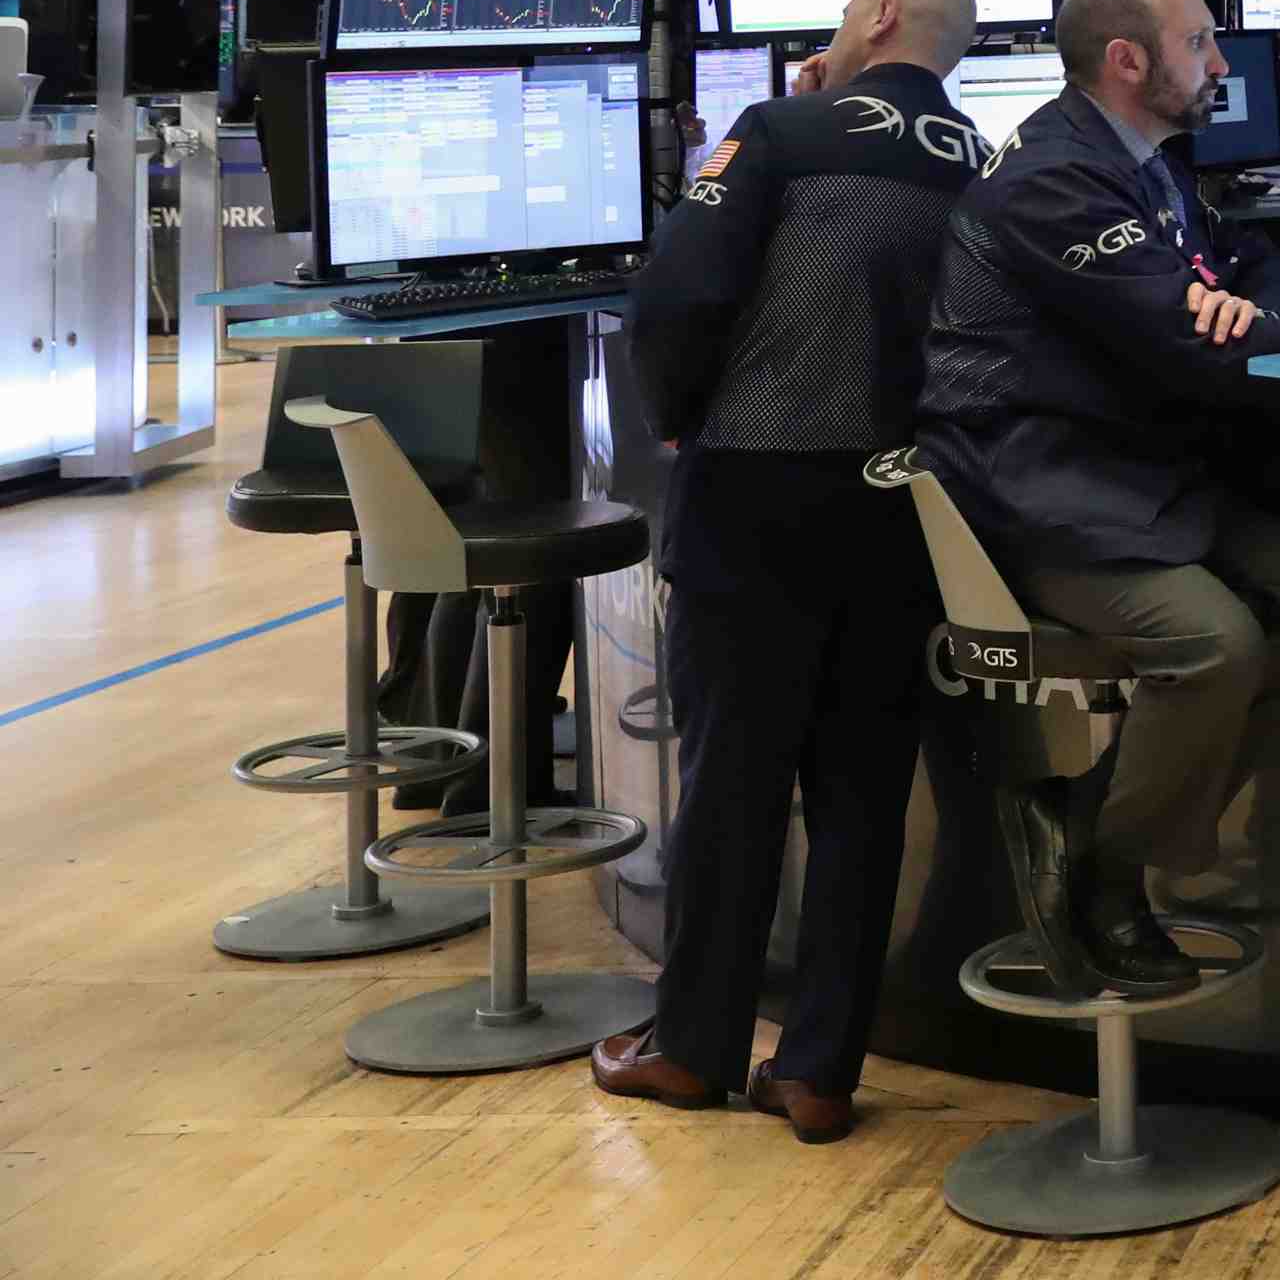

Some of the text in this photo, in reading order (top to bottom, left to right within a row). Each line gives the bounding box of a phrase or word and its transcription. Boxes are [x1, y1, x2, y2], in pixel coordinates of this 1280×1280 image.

[689, 180, 728, 205] GTS
[151, 206, 264, 228] EW RK
[1098, 220, 1146, 254] GTS
[983, 647, 1018, 668] GTS
